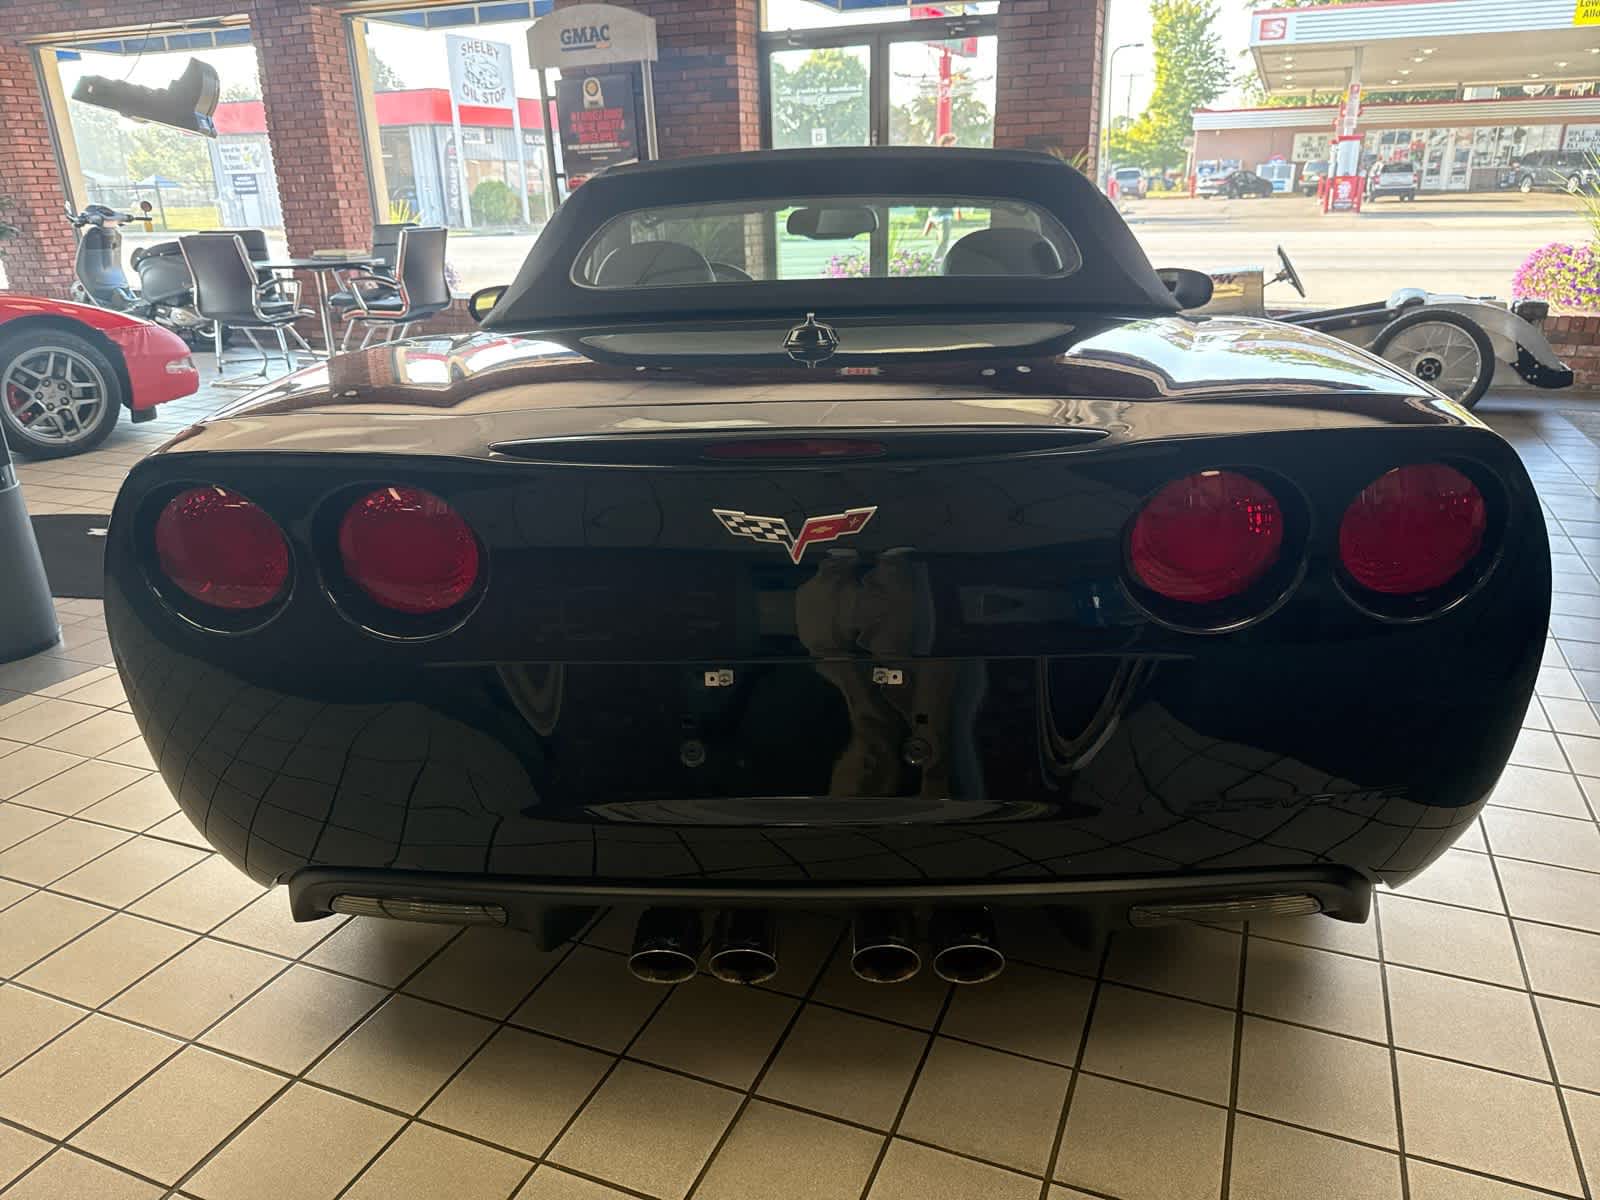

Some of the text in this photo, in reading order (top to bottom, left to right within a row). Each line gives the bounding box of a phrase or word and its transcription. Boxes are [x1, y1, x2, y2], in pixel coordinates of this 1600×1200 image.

[560, 23, 610, 45] GMAC
[460, 39, 499, 61] SHELBY
[462, 83, 506, 104] OIL STOP
